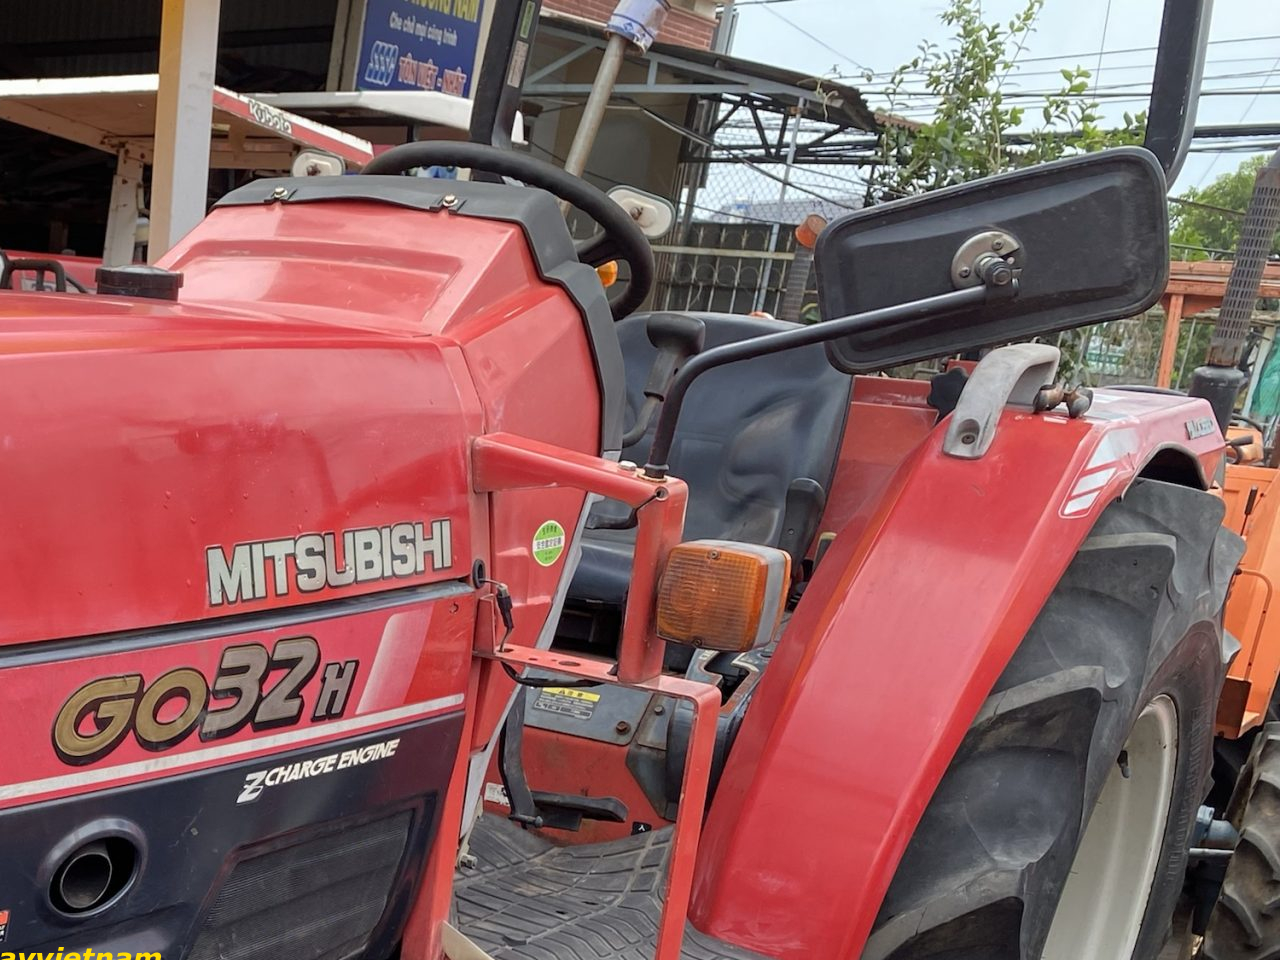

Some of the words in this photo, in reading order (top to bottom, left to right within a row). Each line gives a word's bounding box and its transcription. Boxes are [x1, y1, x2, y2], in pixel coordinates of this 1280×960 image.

[248, 99, 292, 135] Kubota
[205, 518, 452, 608] MITSUBISHI
[337, 738, 401, 770] ENGINE
